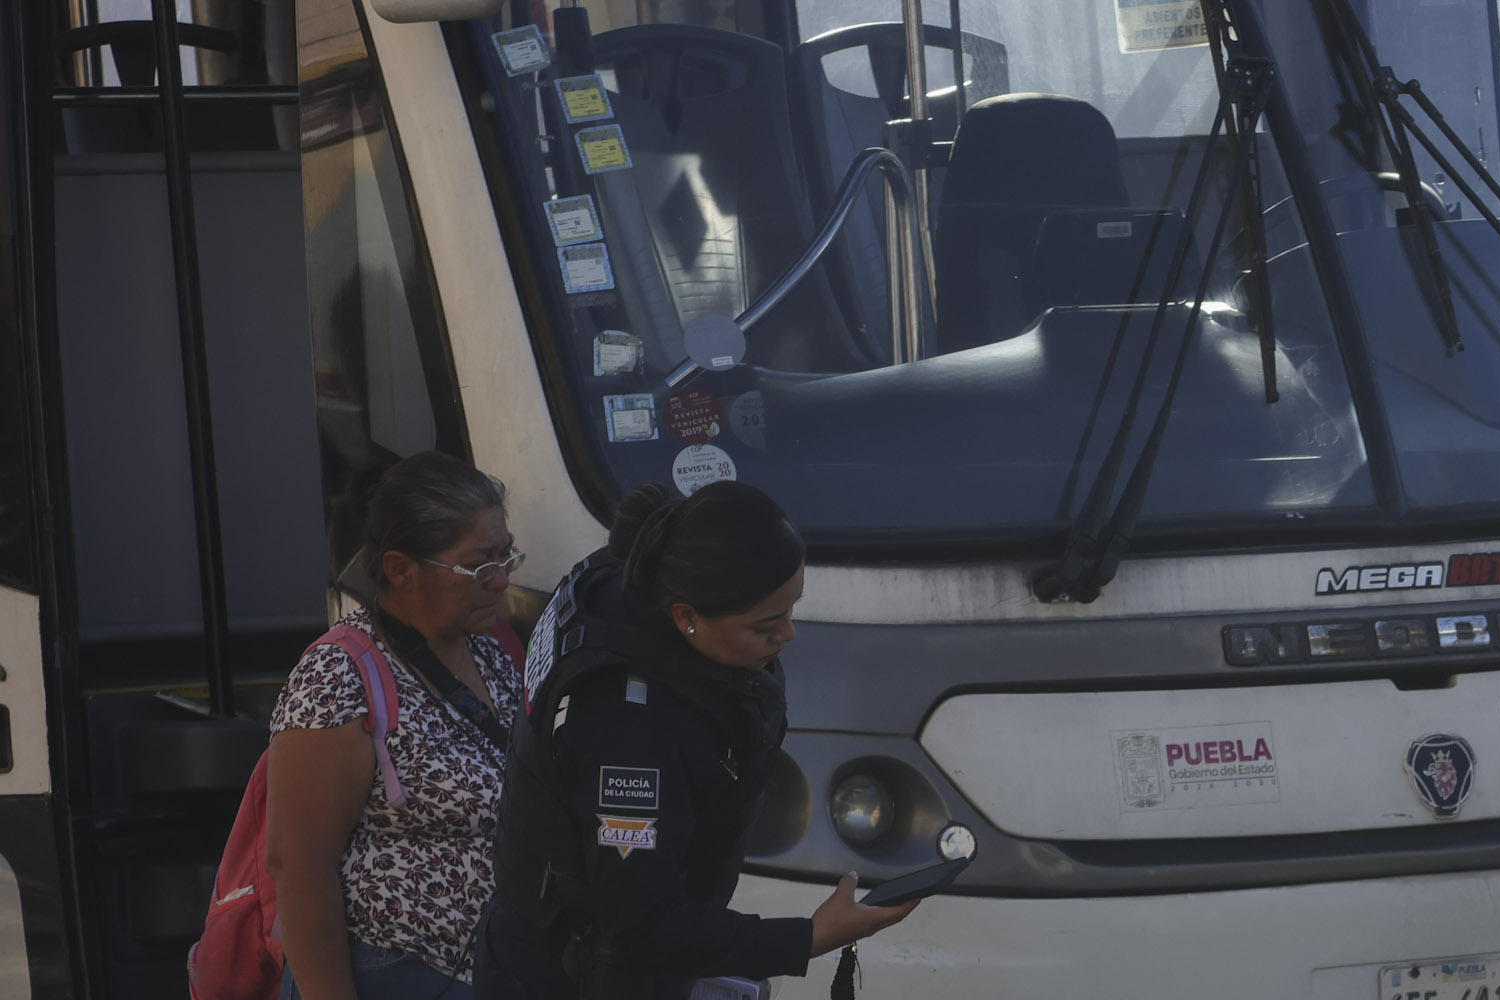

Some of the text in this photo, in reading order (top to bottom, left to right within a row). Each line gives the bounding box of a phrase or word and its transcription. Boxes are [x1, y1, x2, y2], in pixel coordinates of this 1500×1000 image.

[1144, 7, 1201, 24] ASIENTOS
[1134, 24, 1207, 41] PREFERENTE
[674, 408, 710, 420] REVISTA
[671, 414, 721, 429] VEHICULAR
[680, 425, 702, 437] 2019
[676, 464, 713, 475] REVISTA
[717, 461, 730, 471] 20
[719, 469, 731, 478] 20
[1316, 562, 1443, 594] MEGA
[1165, 738, 1273, 767] PUEBLA
[1168, 764, 1275, 780] Gobierno del Estado
[608, 778, 650, 789] POLICÍA
[604, 788, 655, 799] DE LA CIUDAD
[602, 827, 650, 842] CALEA
